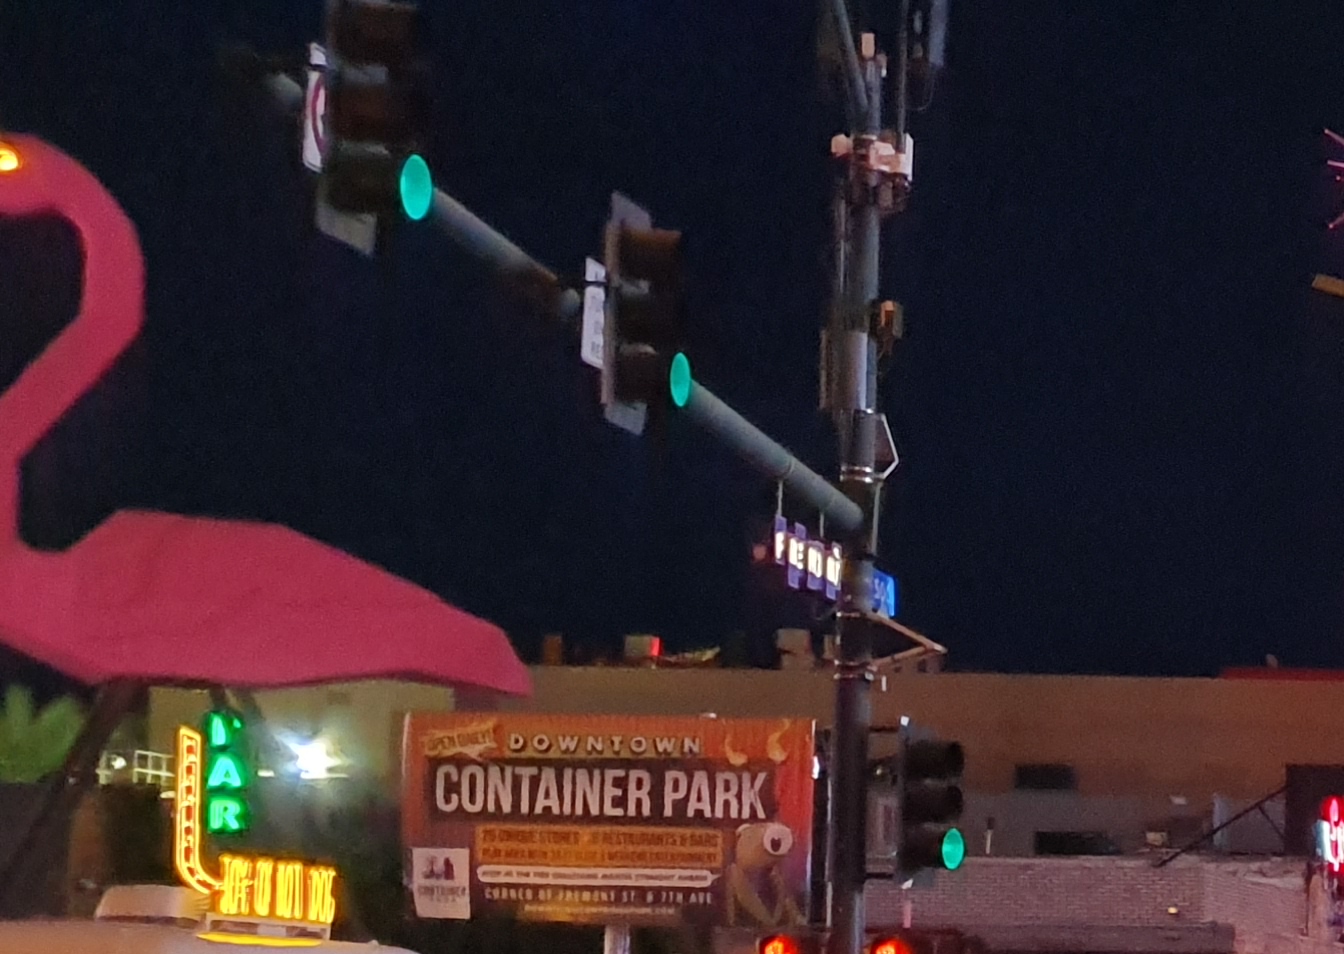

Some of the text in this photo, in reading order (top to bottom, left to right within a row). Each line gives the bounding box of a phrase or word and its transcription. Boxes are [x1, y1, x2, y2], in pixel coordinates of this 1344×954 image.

[509, 732, 701, 754] DOWNTOWN
[435, 763, 770, 820] CONTAINER PARK
